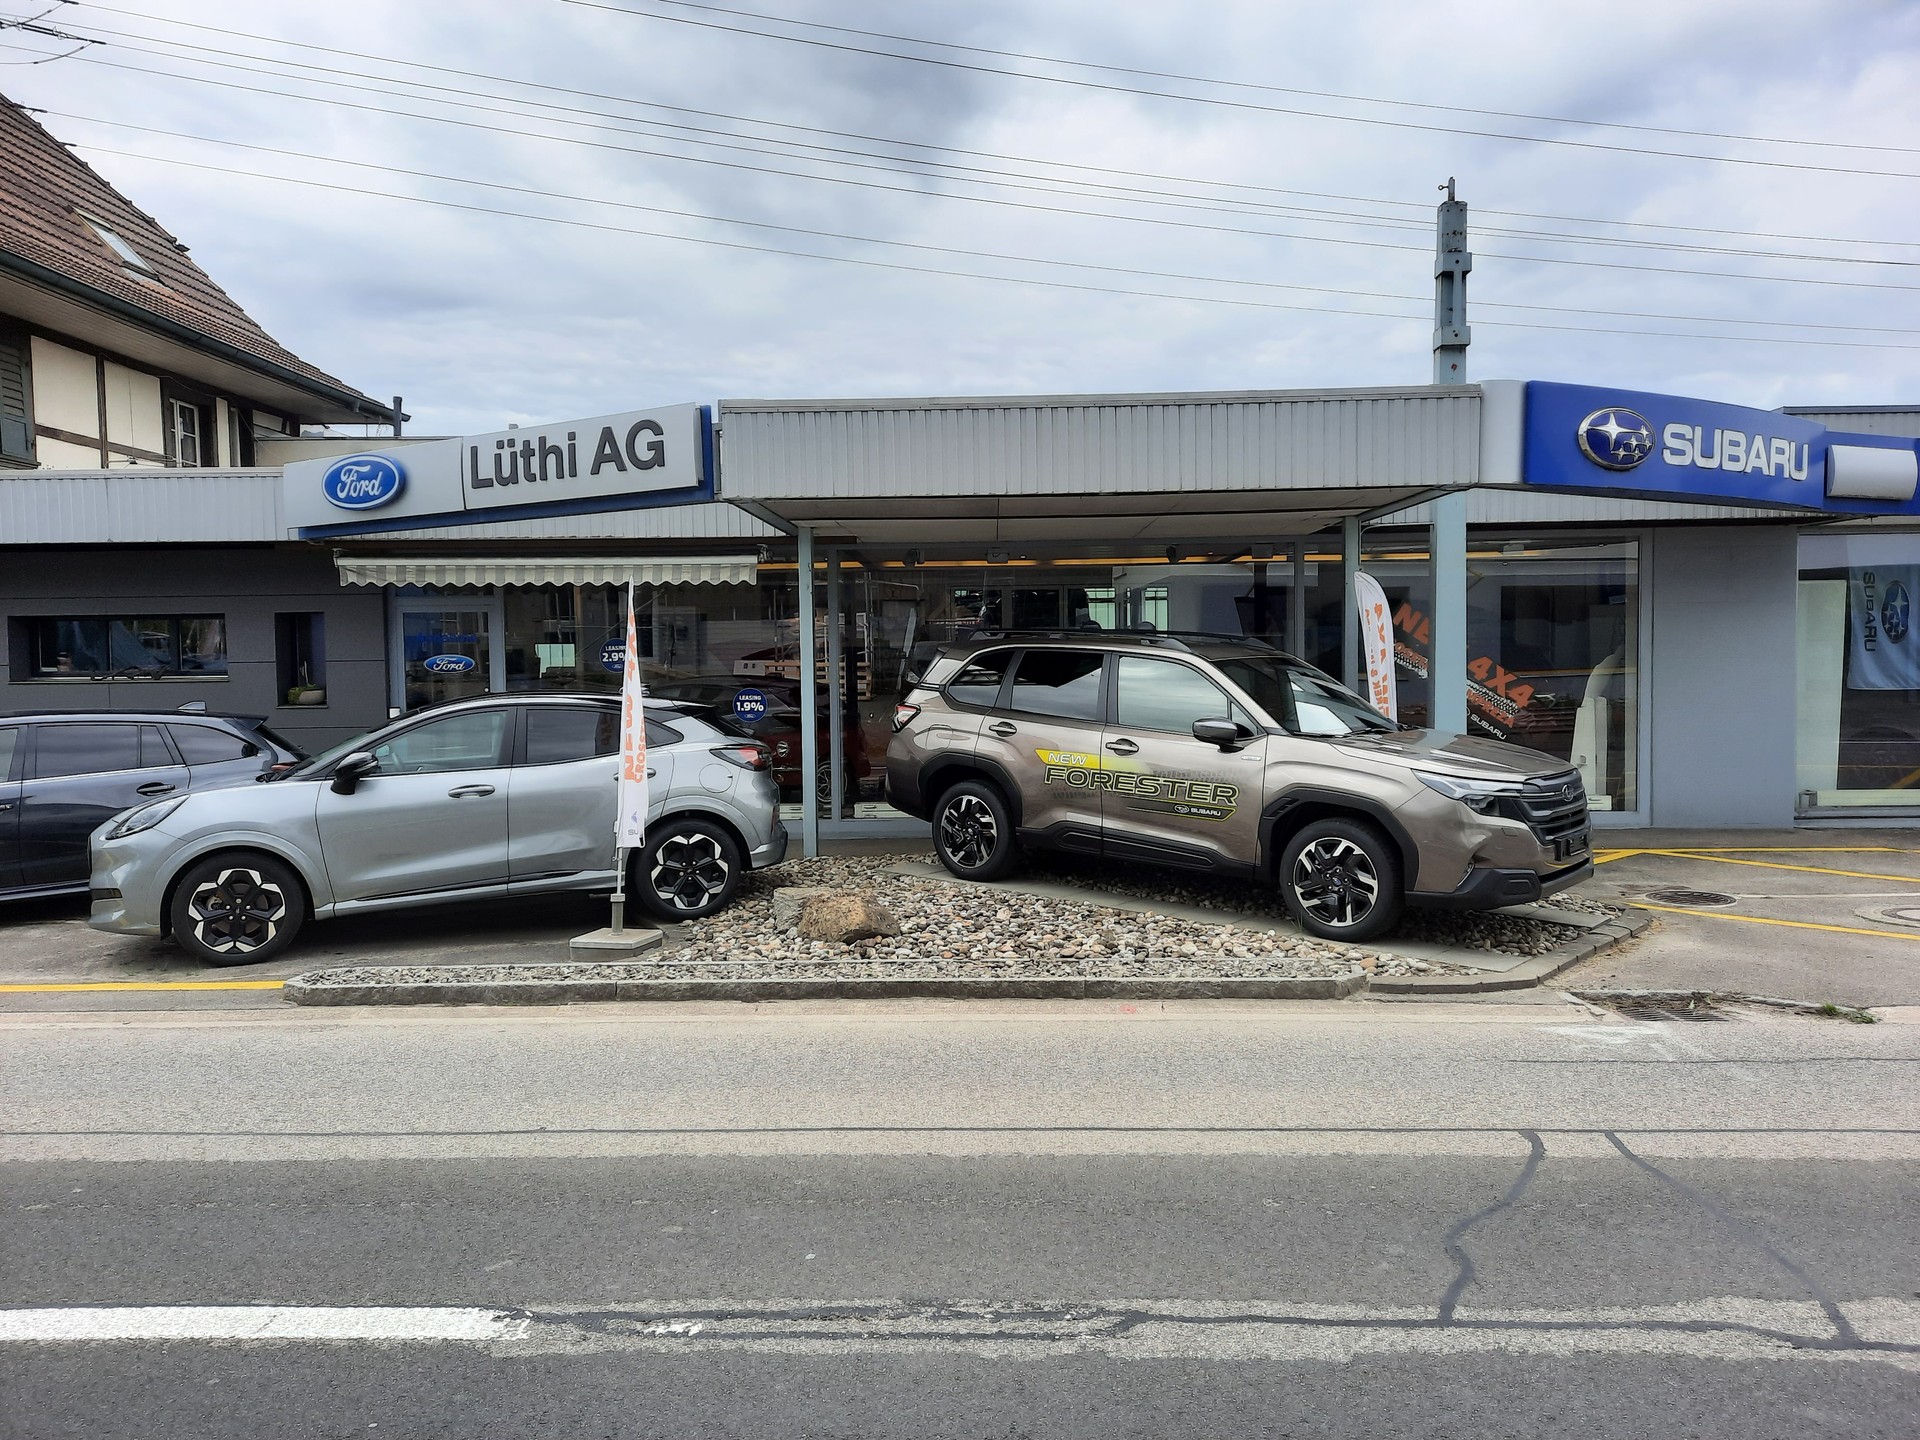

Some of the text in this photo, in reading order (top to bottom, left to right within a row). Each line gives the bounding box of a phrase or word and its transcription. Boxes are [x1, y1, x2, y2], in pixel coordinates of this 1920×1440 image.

[470, 419, 666, 489] Lüthi AG
[1662, 423, 1809, 481] SUBARU
[336, 464, 383, 499] Ford
[1863, 571, 1877, 652] SUBARU
[433, 657, 466, 671] Ford
[1468, 656, 1535, 709] 4X4
[736, 702, 764, 711] 1.9%
[1470, 713, 1507, 740] SUBARU
[1048, 752, 1088, 765] NEW
[1044, 765, 1240, 806] FORESTER
[1190, 807, 1221, 816] SUBARU
